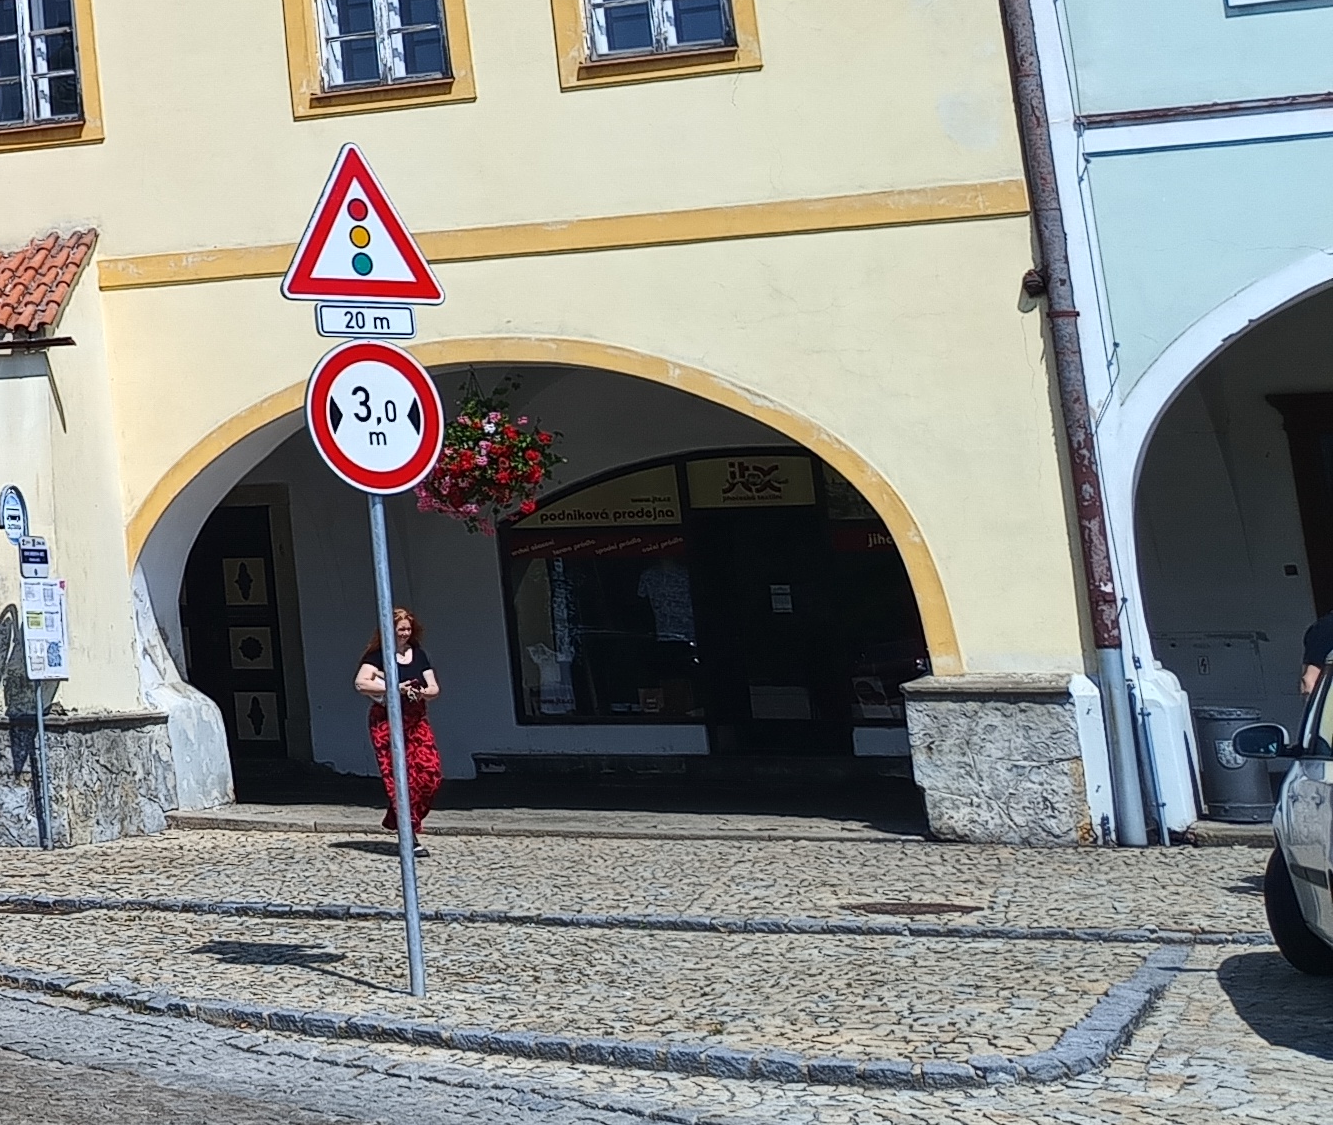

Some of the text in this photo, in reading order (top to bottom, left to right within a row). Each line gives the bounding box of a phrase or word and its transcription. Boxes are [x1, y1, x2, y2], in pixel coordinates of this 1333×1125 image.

[343, 310, 391, 330] 20 m
[351, 385, 398, 427] 3,0
[368, 431, 388, 446] m
[539, 505, 675, 524] podniková prodejna
